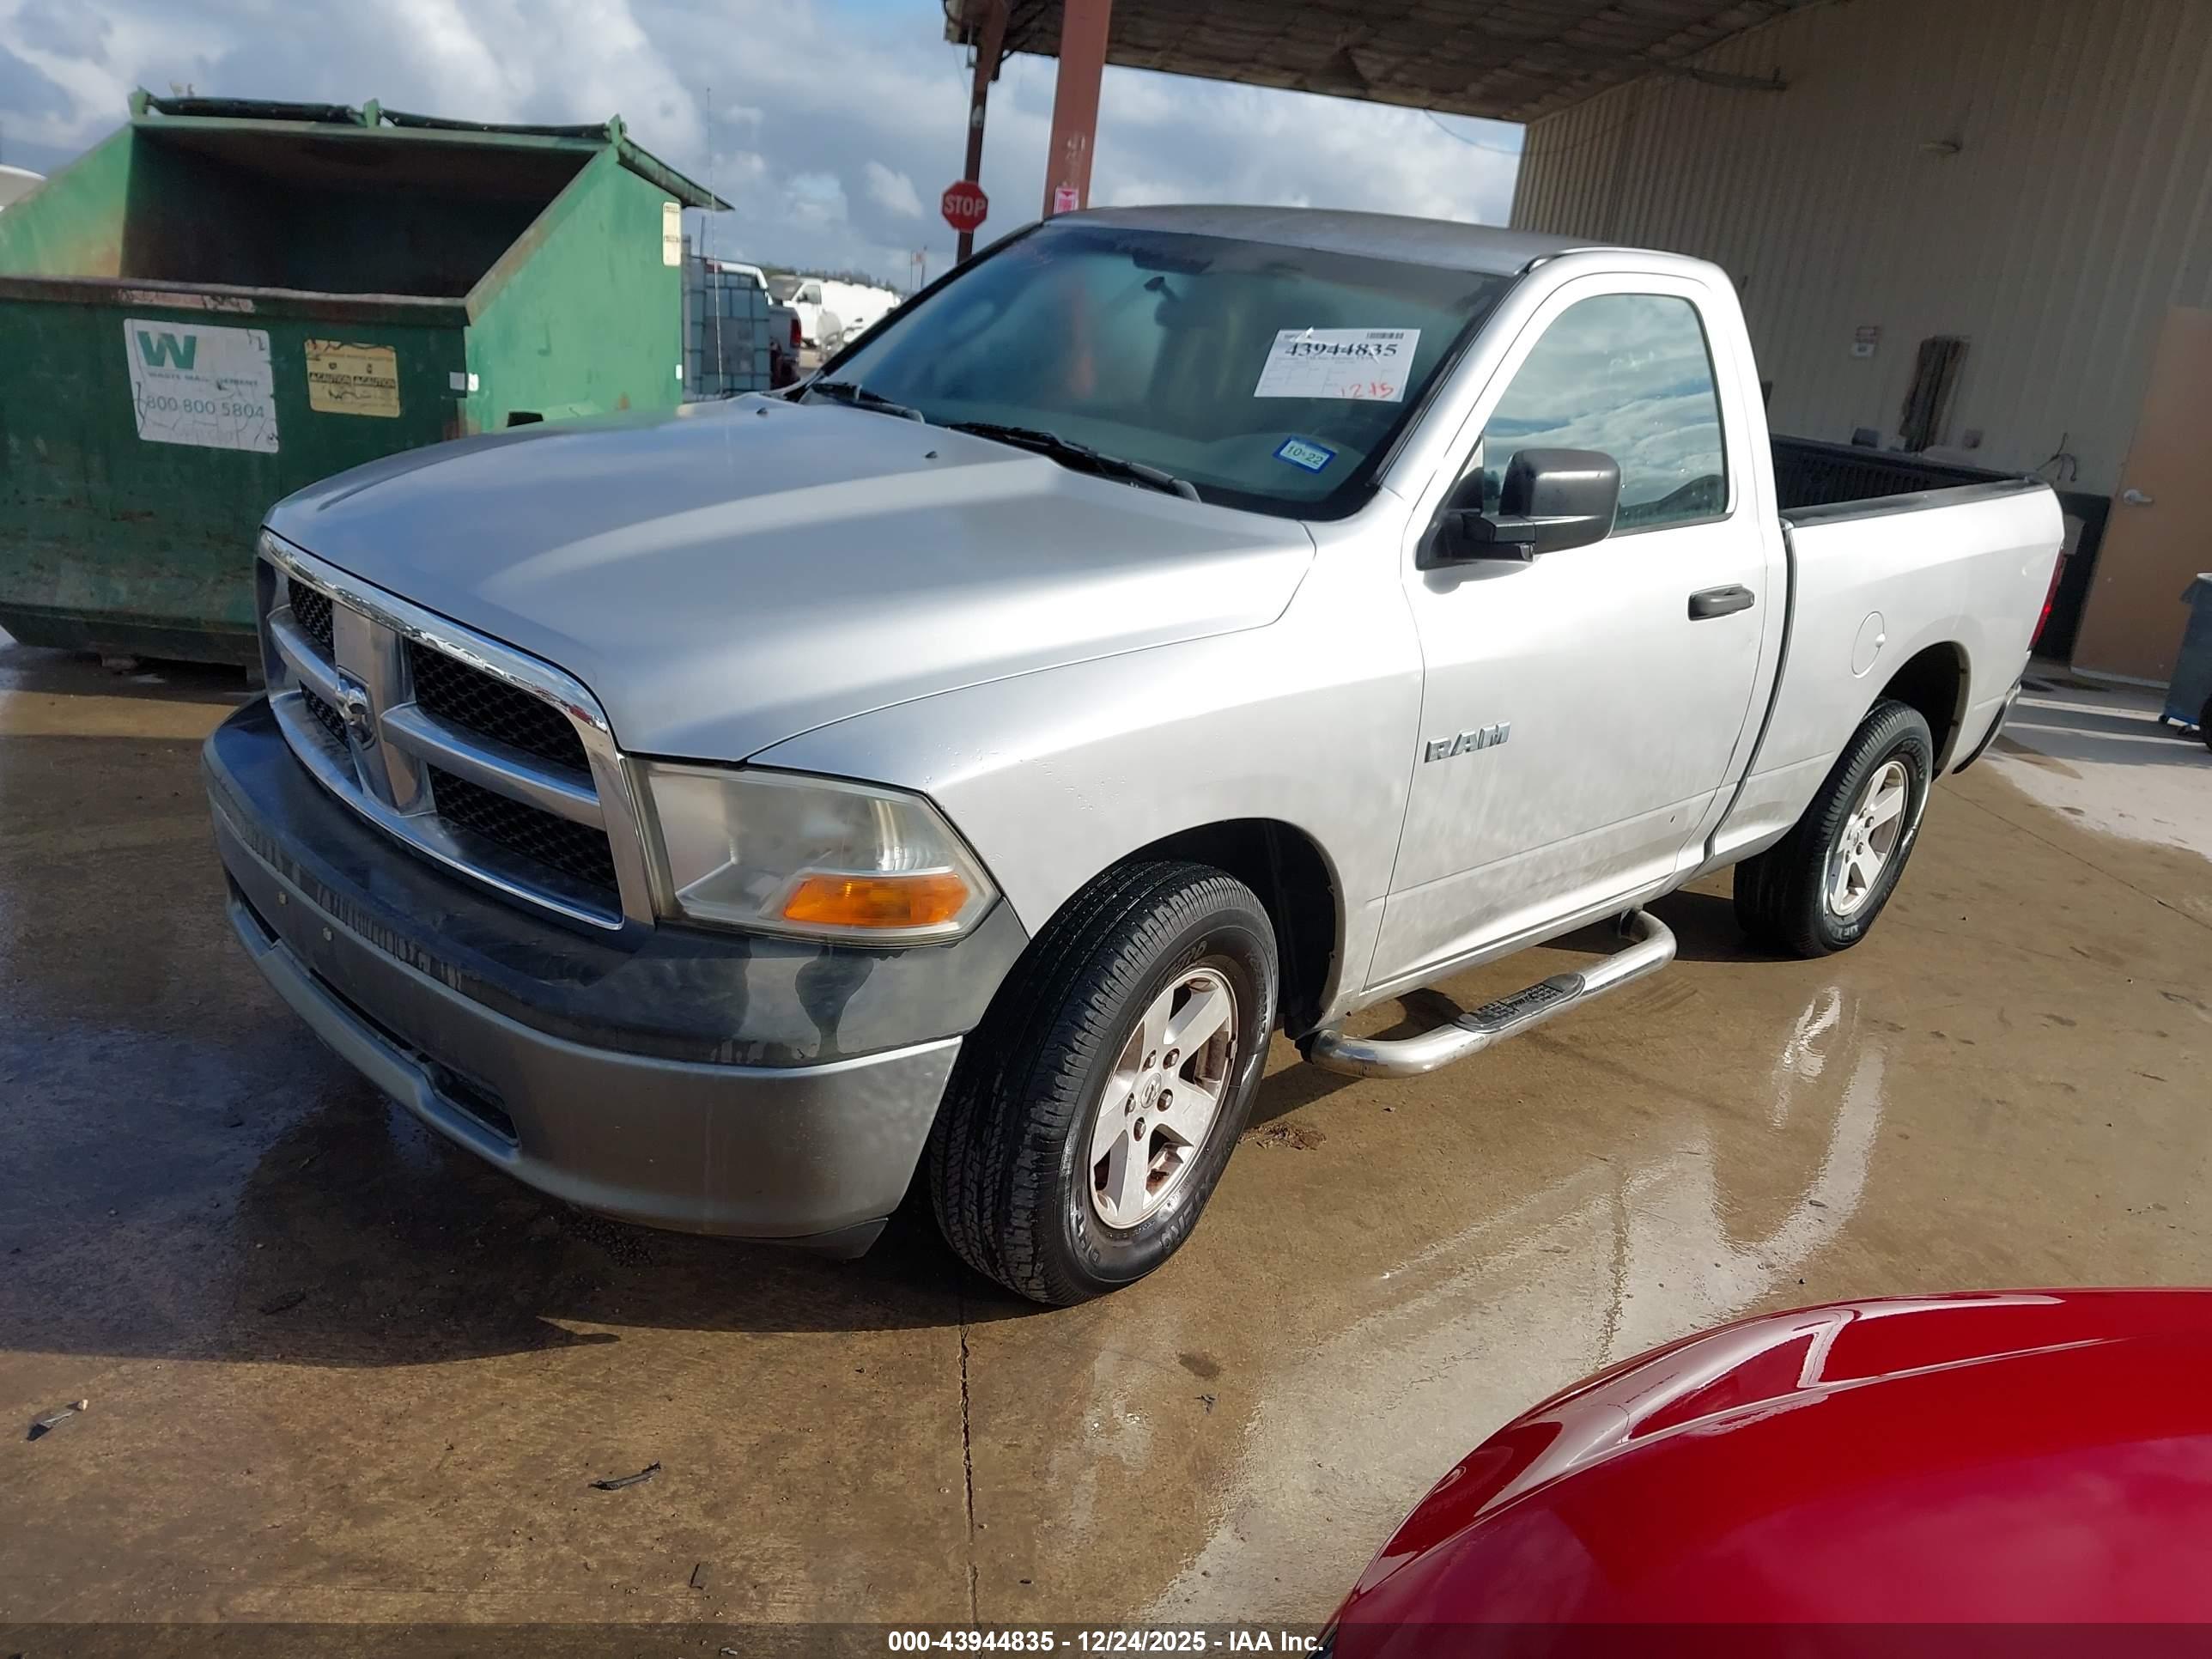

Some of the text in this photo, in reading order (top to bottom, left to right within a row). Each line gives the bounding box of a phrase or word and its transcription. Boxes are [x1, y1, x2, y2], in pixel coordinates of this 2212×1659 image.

[945, 195, 987, 217] STOP
[1285, 342, 1398, 357] 43944835
[147, 396, 265, 419] 800 800 5804
[1425, 721, 1511, 763] RAM
